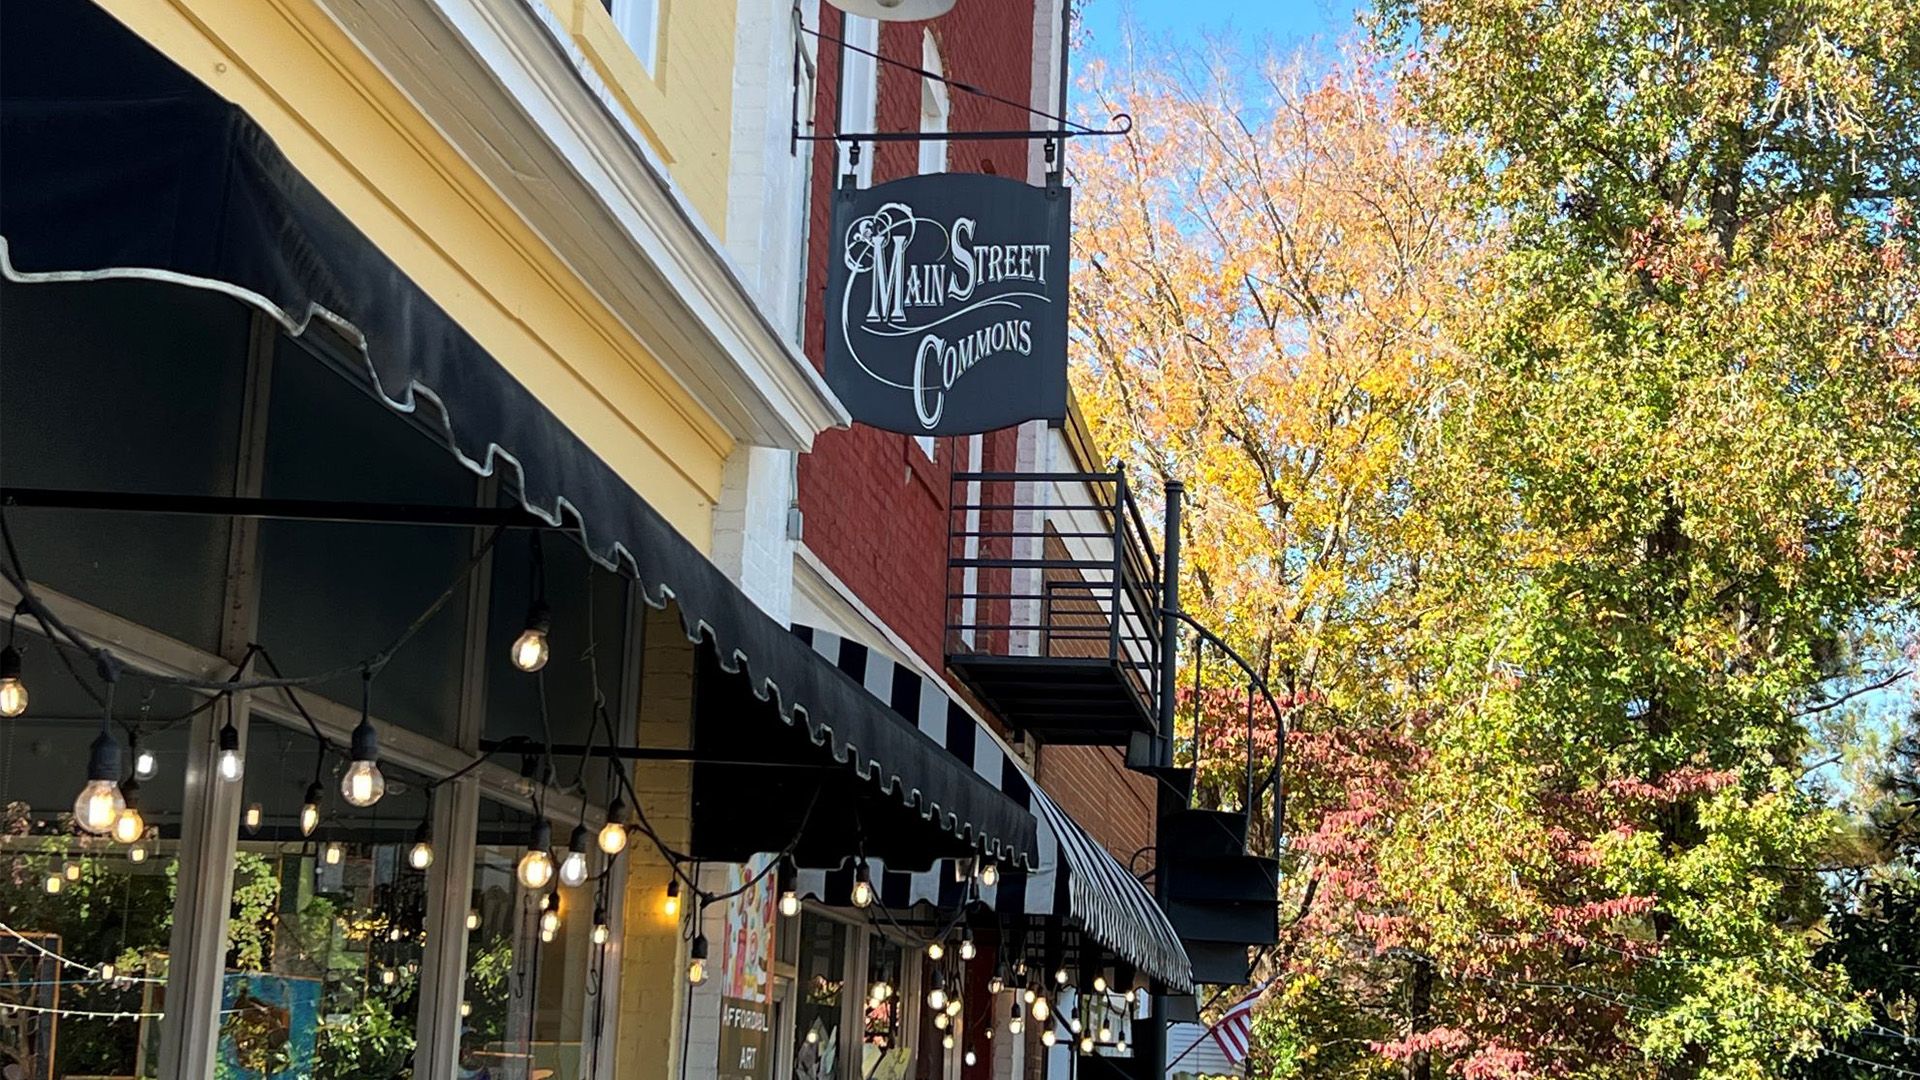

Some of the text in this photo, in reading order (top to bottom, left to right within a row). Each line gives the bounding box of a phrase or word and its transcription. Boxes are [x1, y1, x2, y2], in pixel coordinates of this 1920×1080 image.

[866, 217, 1050, 322] MAIN STREET
[913, 319, 1032, 430] COMMONS
[739, 1046, 757, 1069] ART
